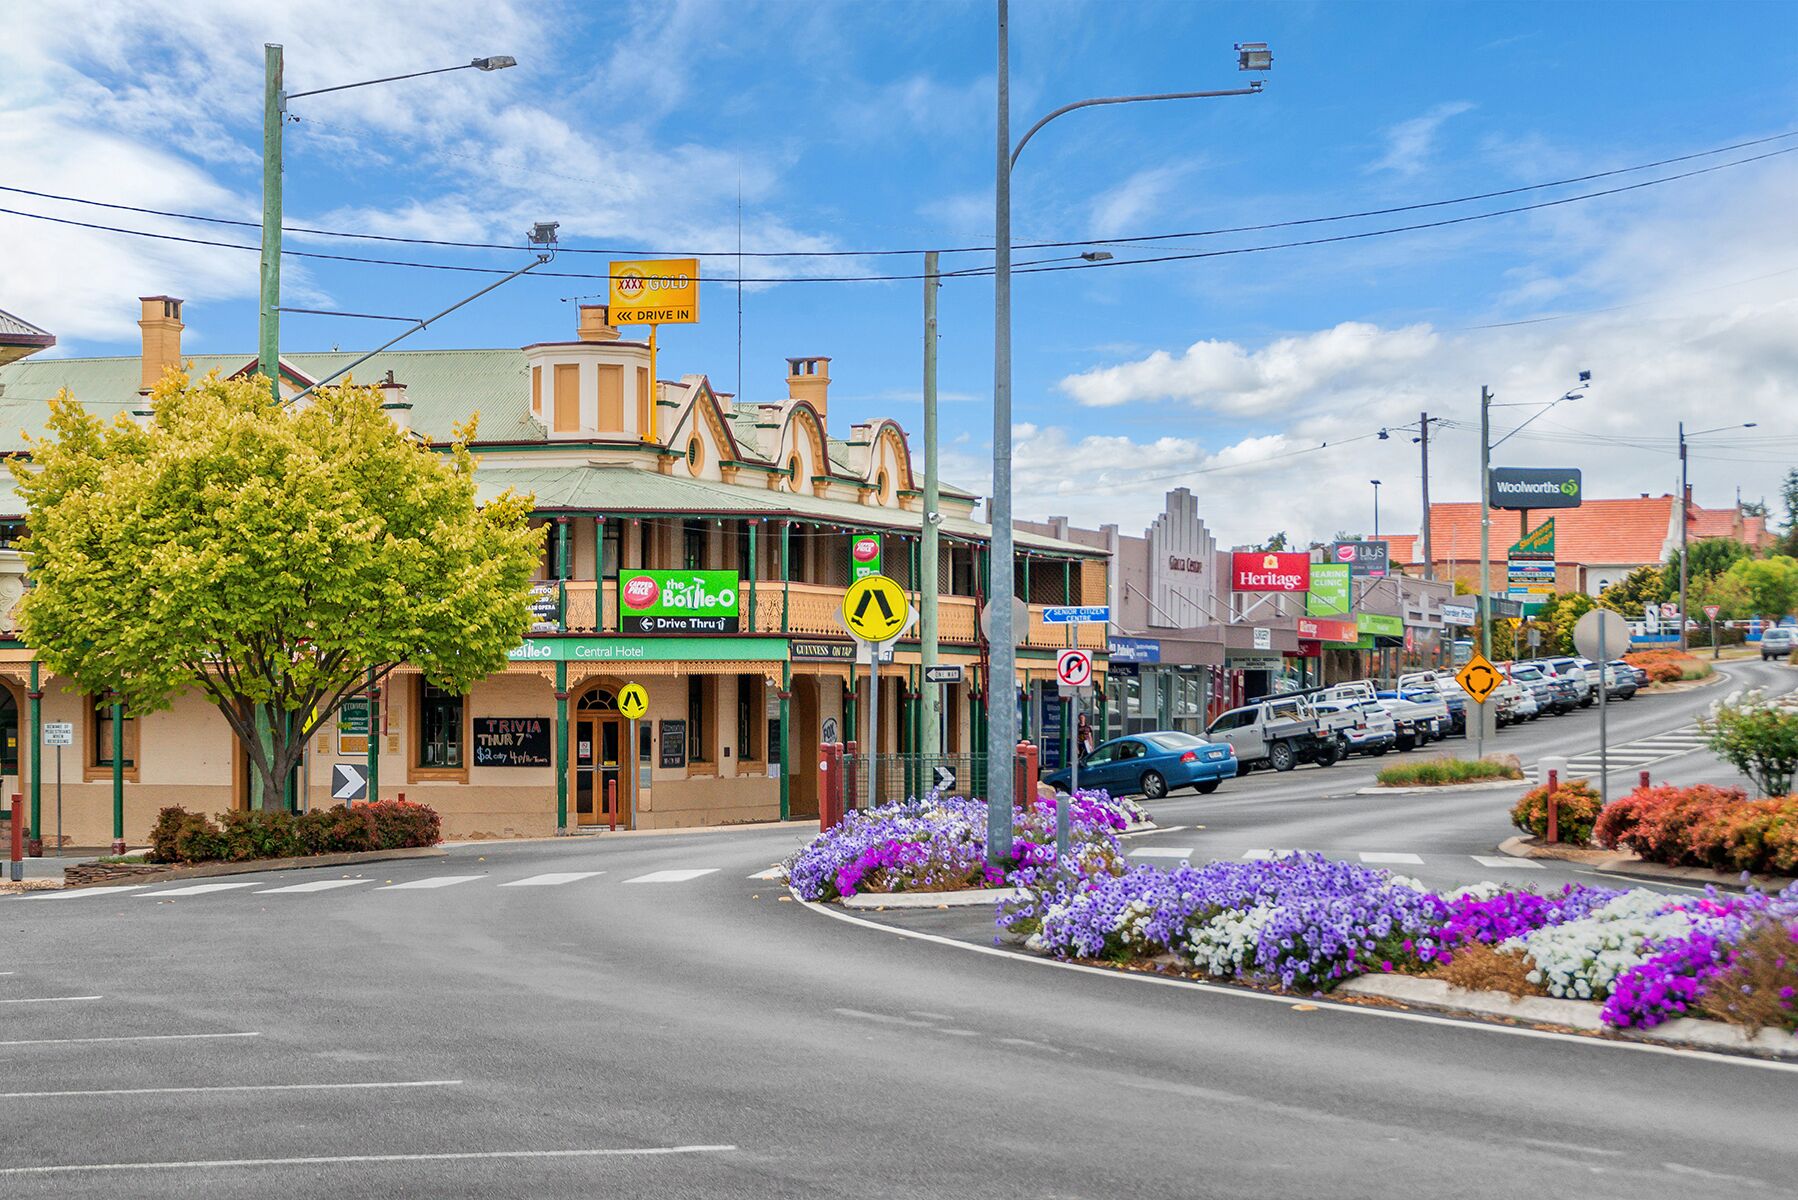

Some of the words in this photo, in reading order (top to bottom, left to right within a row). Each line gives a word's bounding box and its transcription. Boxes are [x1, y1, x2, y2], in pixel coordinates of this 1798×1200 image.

[618, 279, 645, 290] XXXX
[648, 273, 690, 291] GOLD
[637, 310, 673, 320] DRIVE
[677, 309, 689, 319] IN
[1496, 481, 1560, 493] Woolworths
[629, 580, 653, 588] CAPPED
[666, 578, 685, 589] the
[1240, 571, 1302, 590] Heritage
[628, 587, 649, 596] PRICE
[1053, 608, 1077, 616] SENIOR
[657, 618, 687, 629] Drive
[689, 618, 716, 629] Thru
[575, 645, 612, 657] Central
[615, 645, 645, 657] Hotel
[796, 644, 829, 656] GUINNESS
[831, 646, 841, 657] ON
[841, 646, 852, 657] TAP
[486, 720, 541, 733] TRIVIA
[477, 734, 513, 746] THUR
[476, 746, 492, 763] $2
